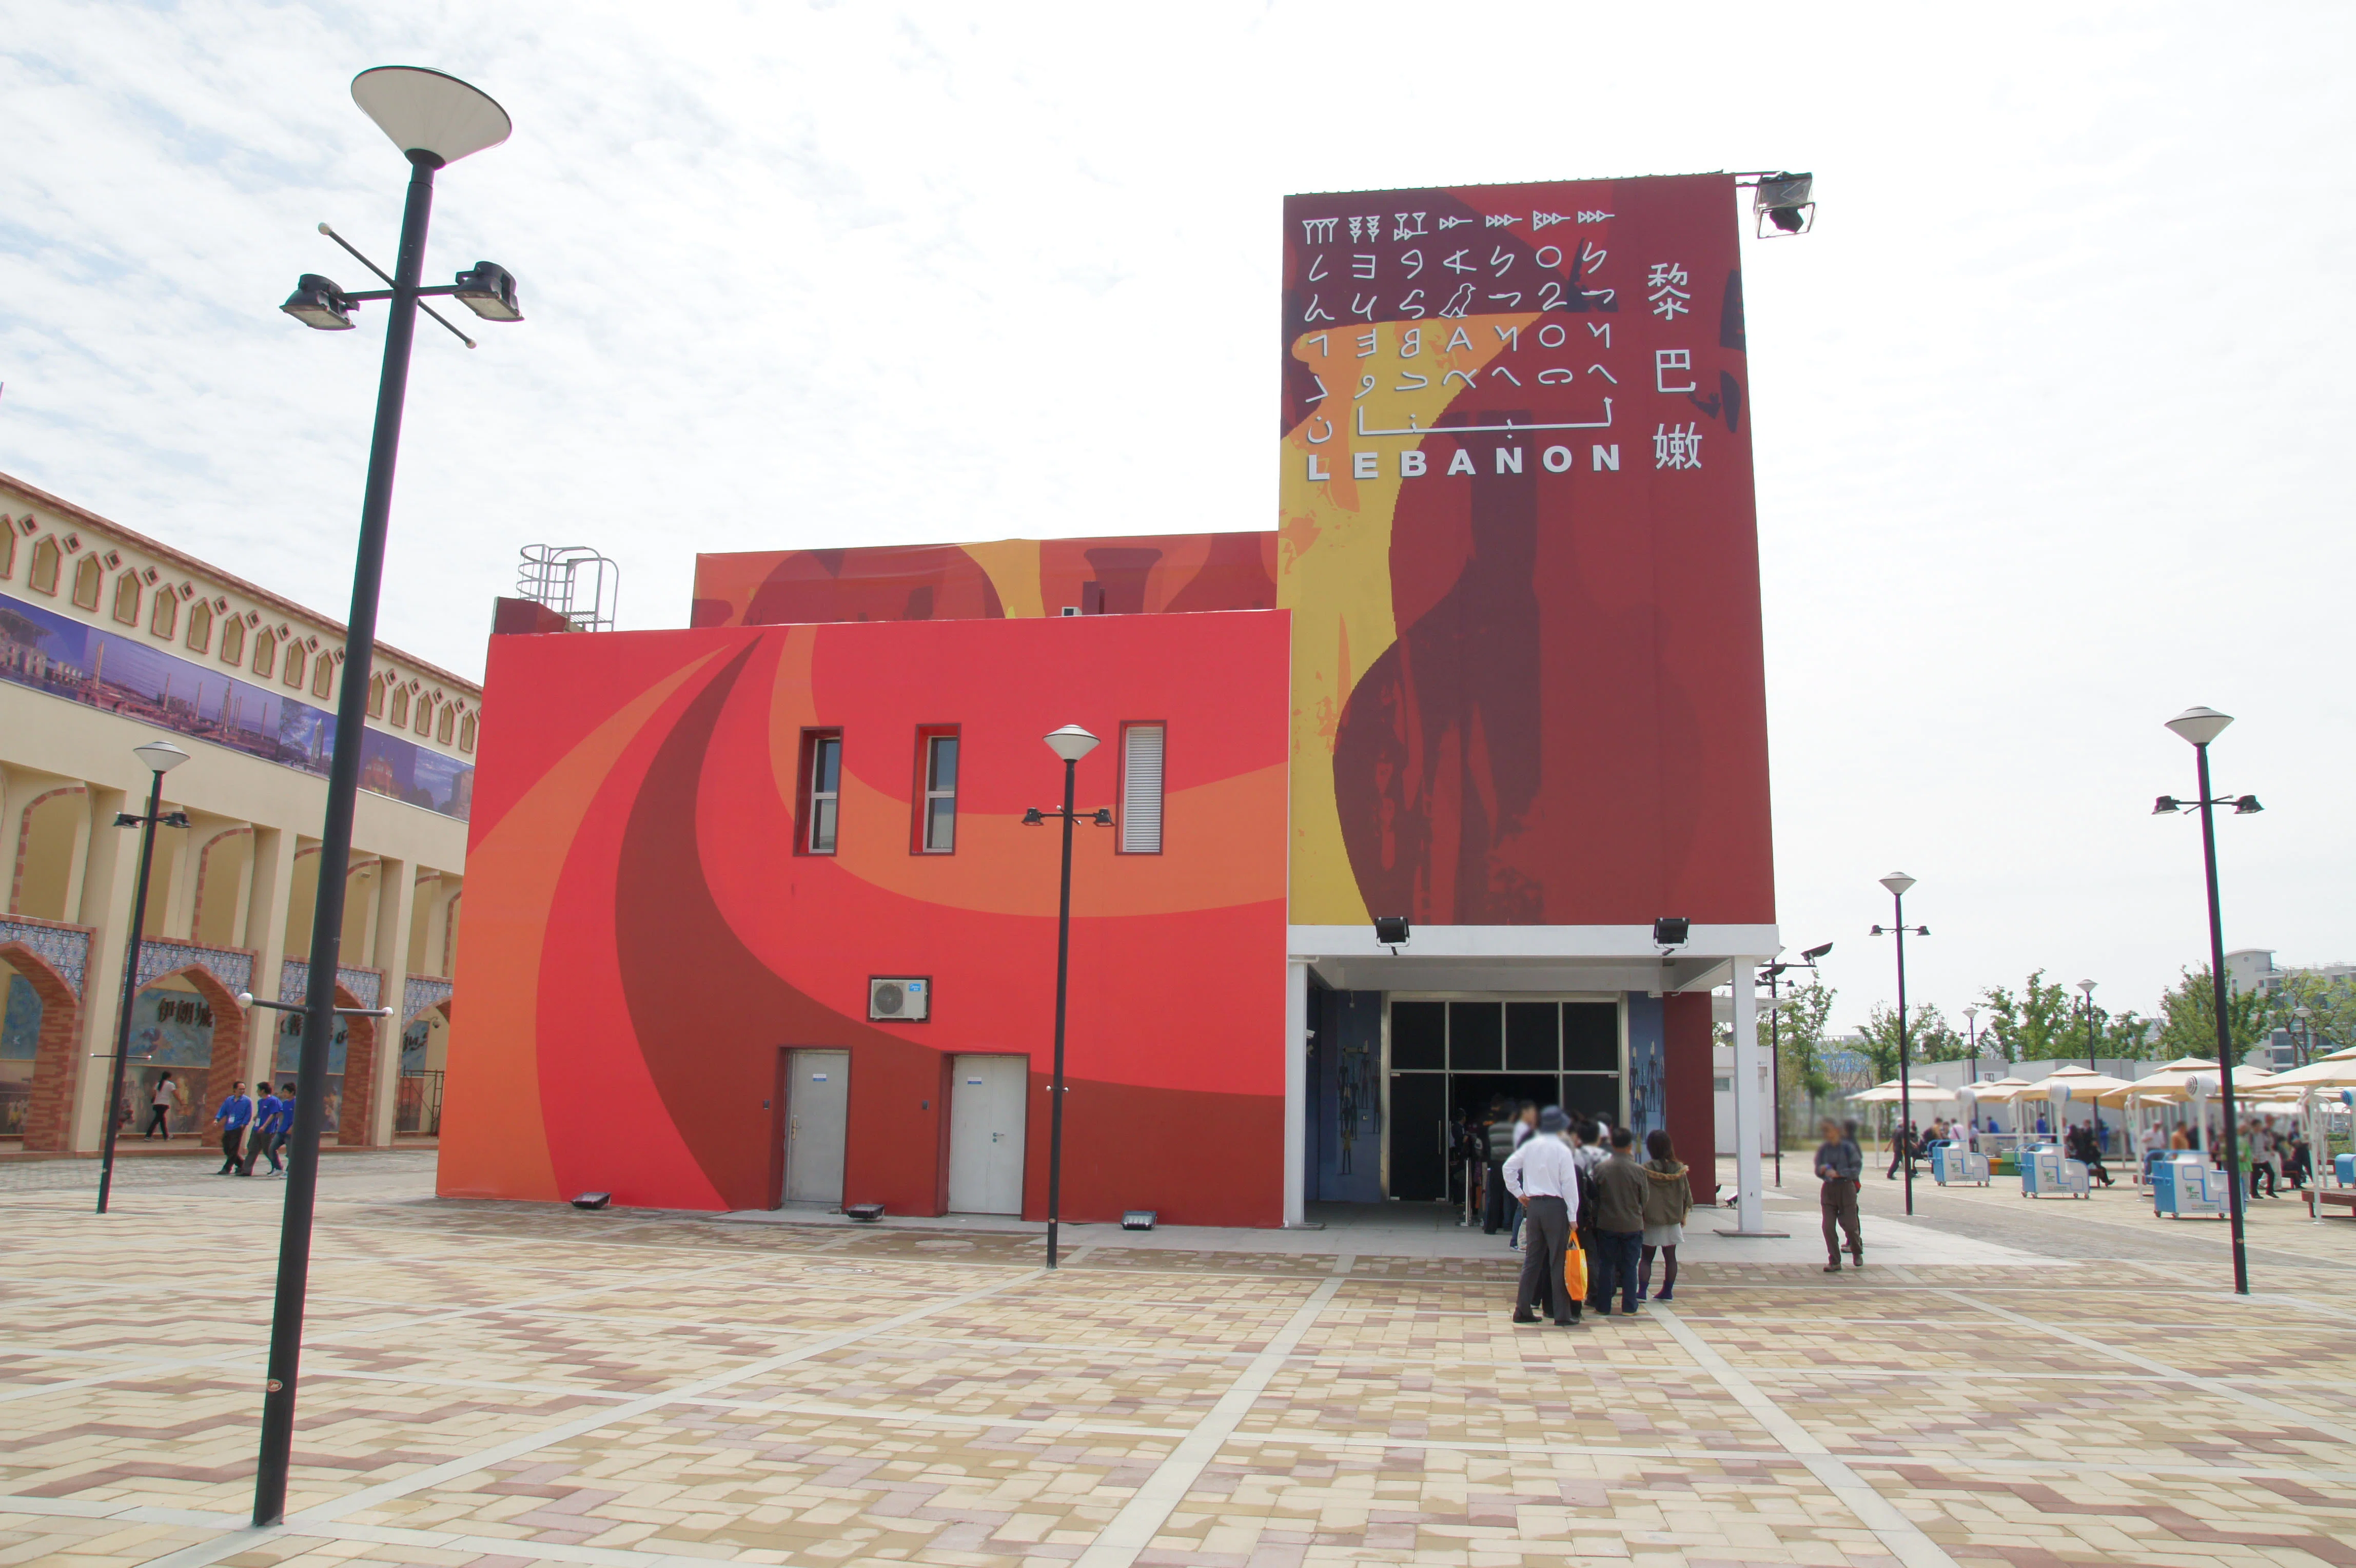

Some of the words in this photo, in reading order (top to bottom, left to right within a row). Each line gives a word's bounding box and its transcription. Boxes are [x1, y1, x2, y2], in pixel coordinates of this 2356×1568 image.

[1647, 262, 1703, 470] 黎巴嫩
[1308, 444, 1620, 481] LEBANON
